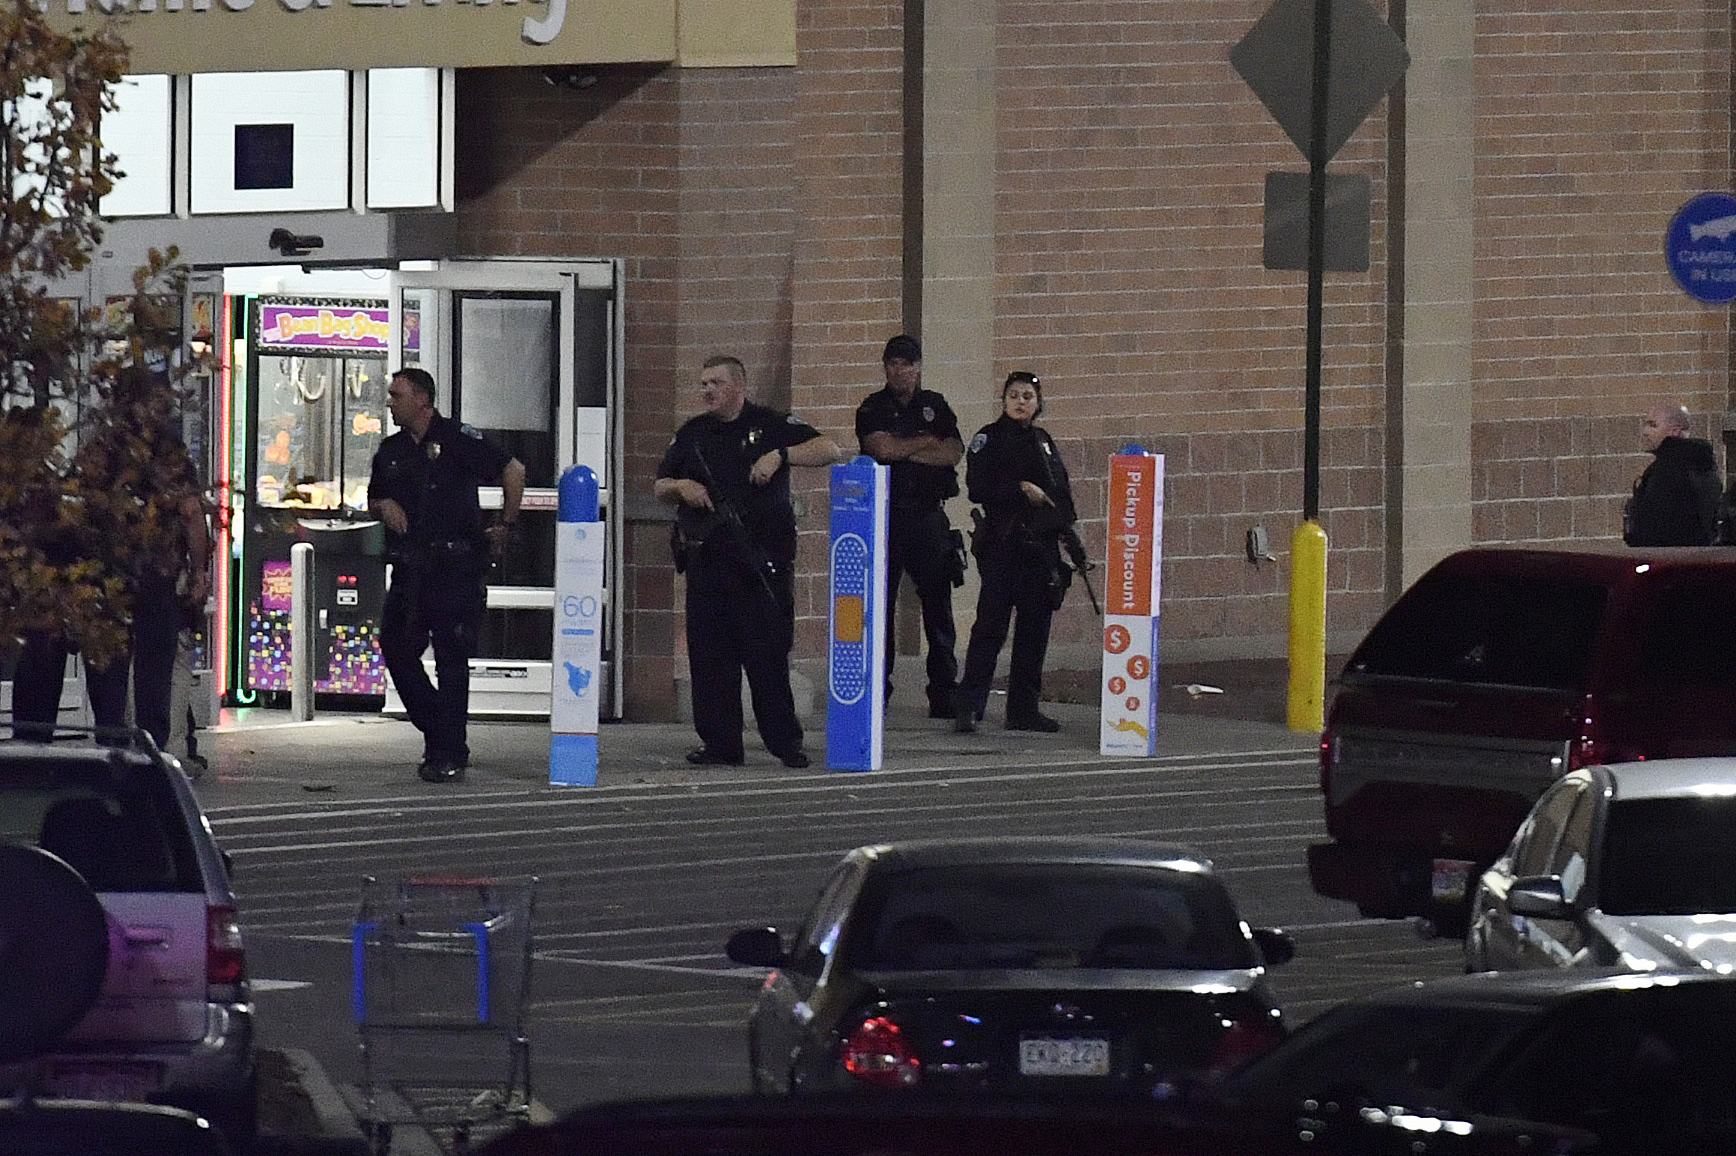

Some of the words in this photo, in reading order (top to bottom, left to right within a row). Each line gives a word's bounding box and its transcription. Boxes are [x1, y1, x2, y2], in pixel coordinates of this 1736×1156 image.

[320, 311, 353, 338] Bag
[1122, 470, 1143, 529] Pickup
[1122, 533, 1140, 610] Discount
